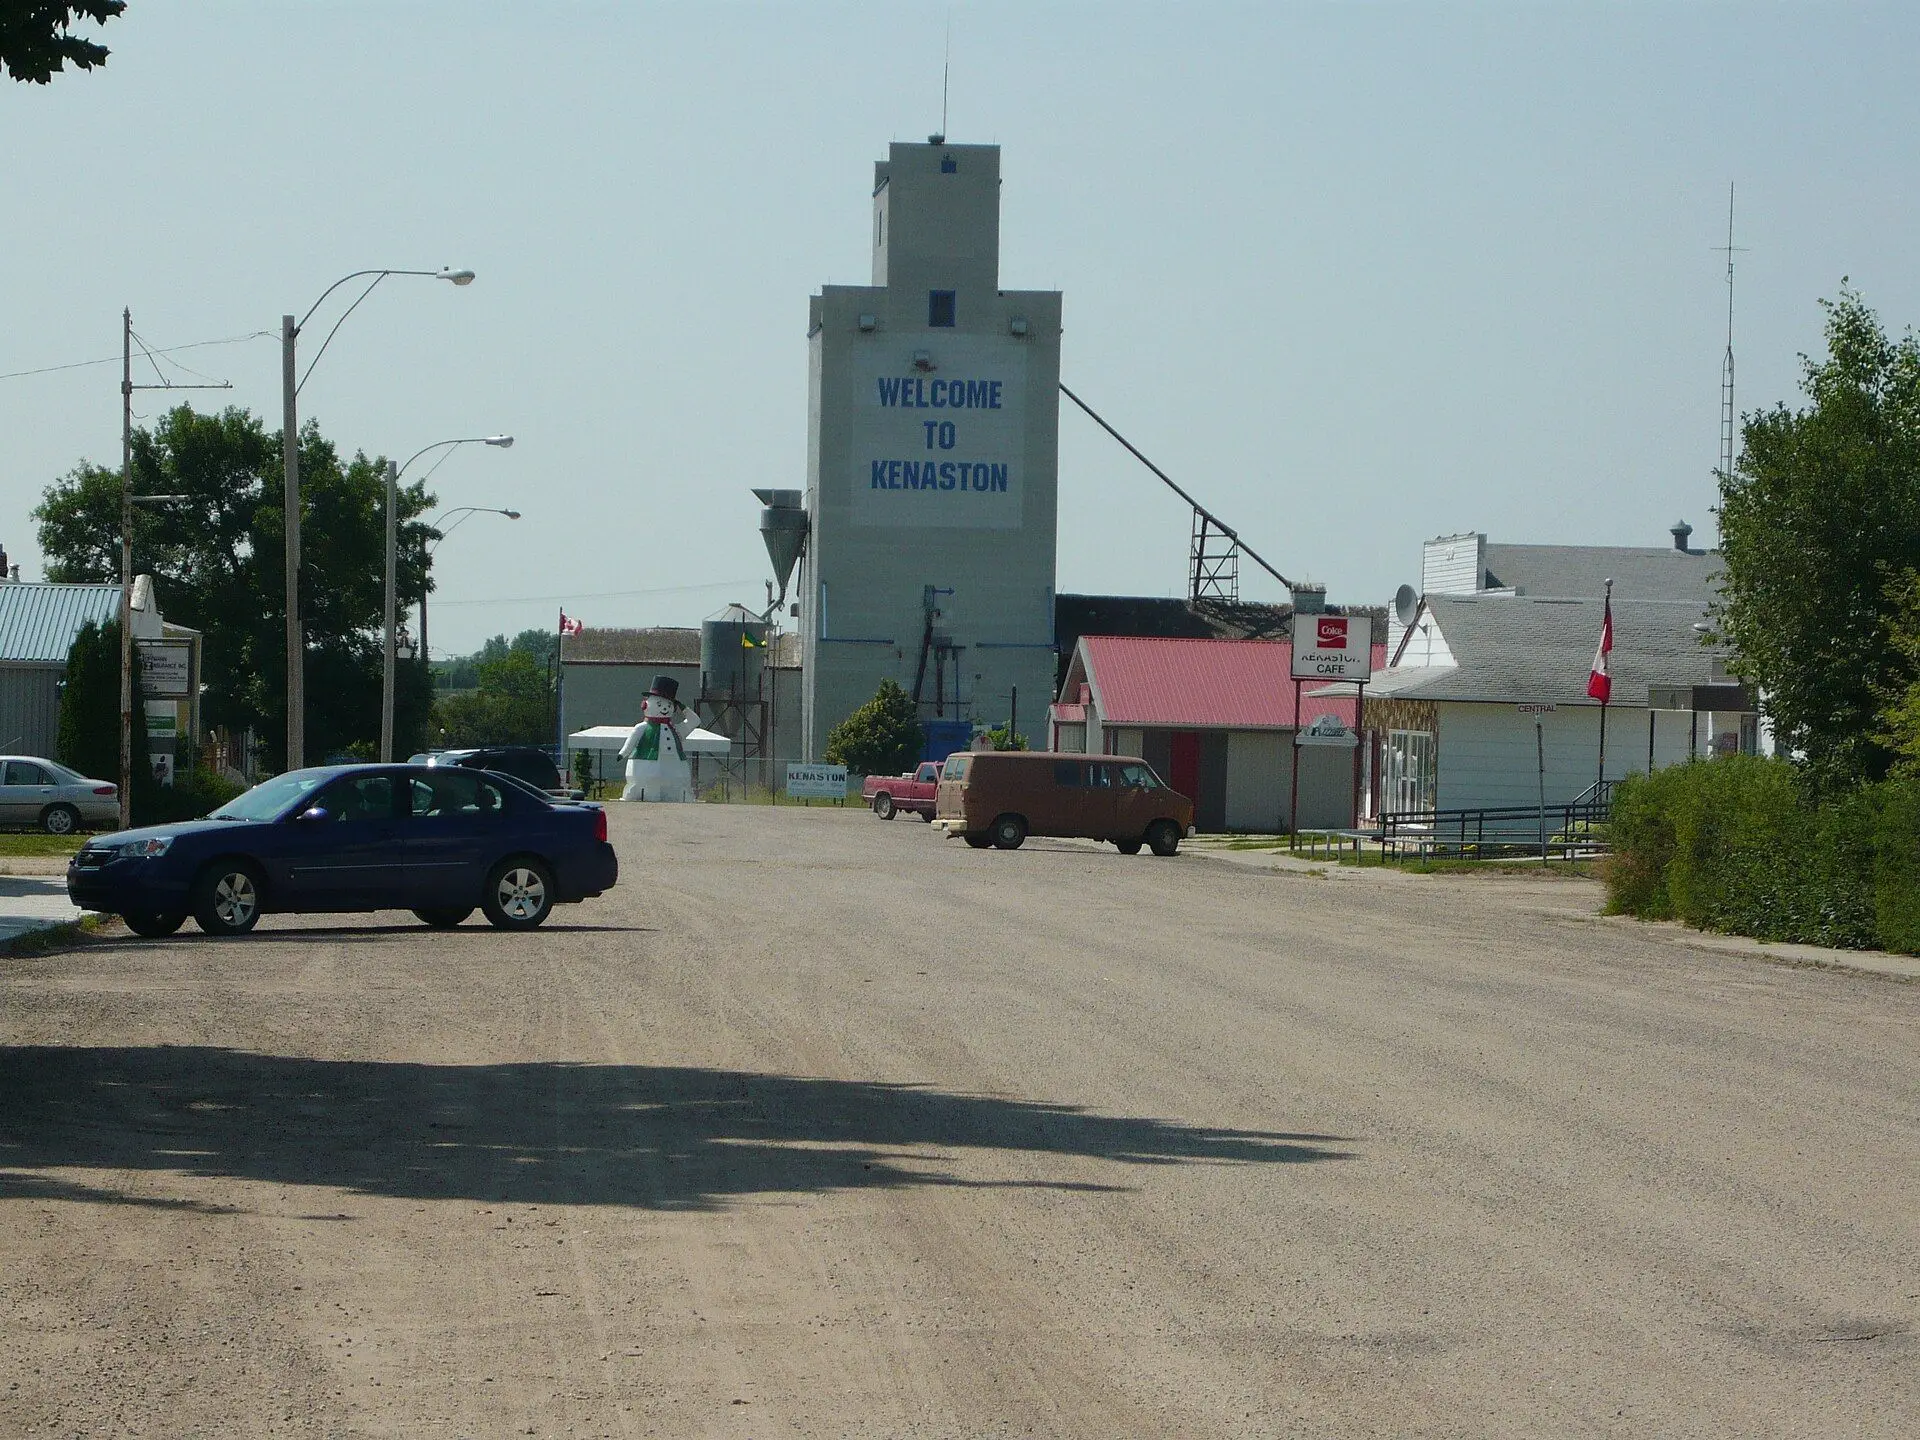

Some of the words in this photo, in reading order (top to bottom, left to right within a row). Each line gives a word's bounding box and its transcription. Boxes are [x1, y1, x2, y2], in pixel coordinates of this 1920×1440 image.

[878, 377, 1003, 409] WELCOME
[923, 420, 956, 450] TO
[871, 460, 1008, 493] KENASTON
[1321, 625, 1343, 636] Coke
[1316, 663, 1346, 674] CAFE
[1518, 704, 1556, 713] CENTRAL
[788, 772, 846, 782] KENASTON
